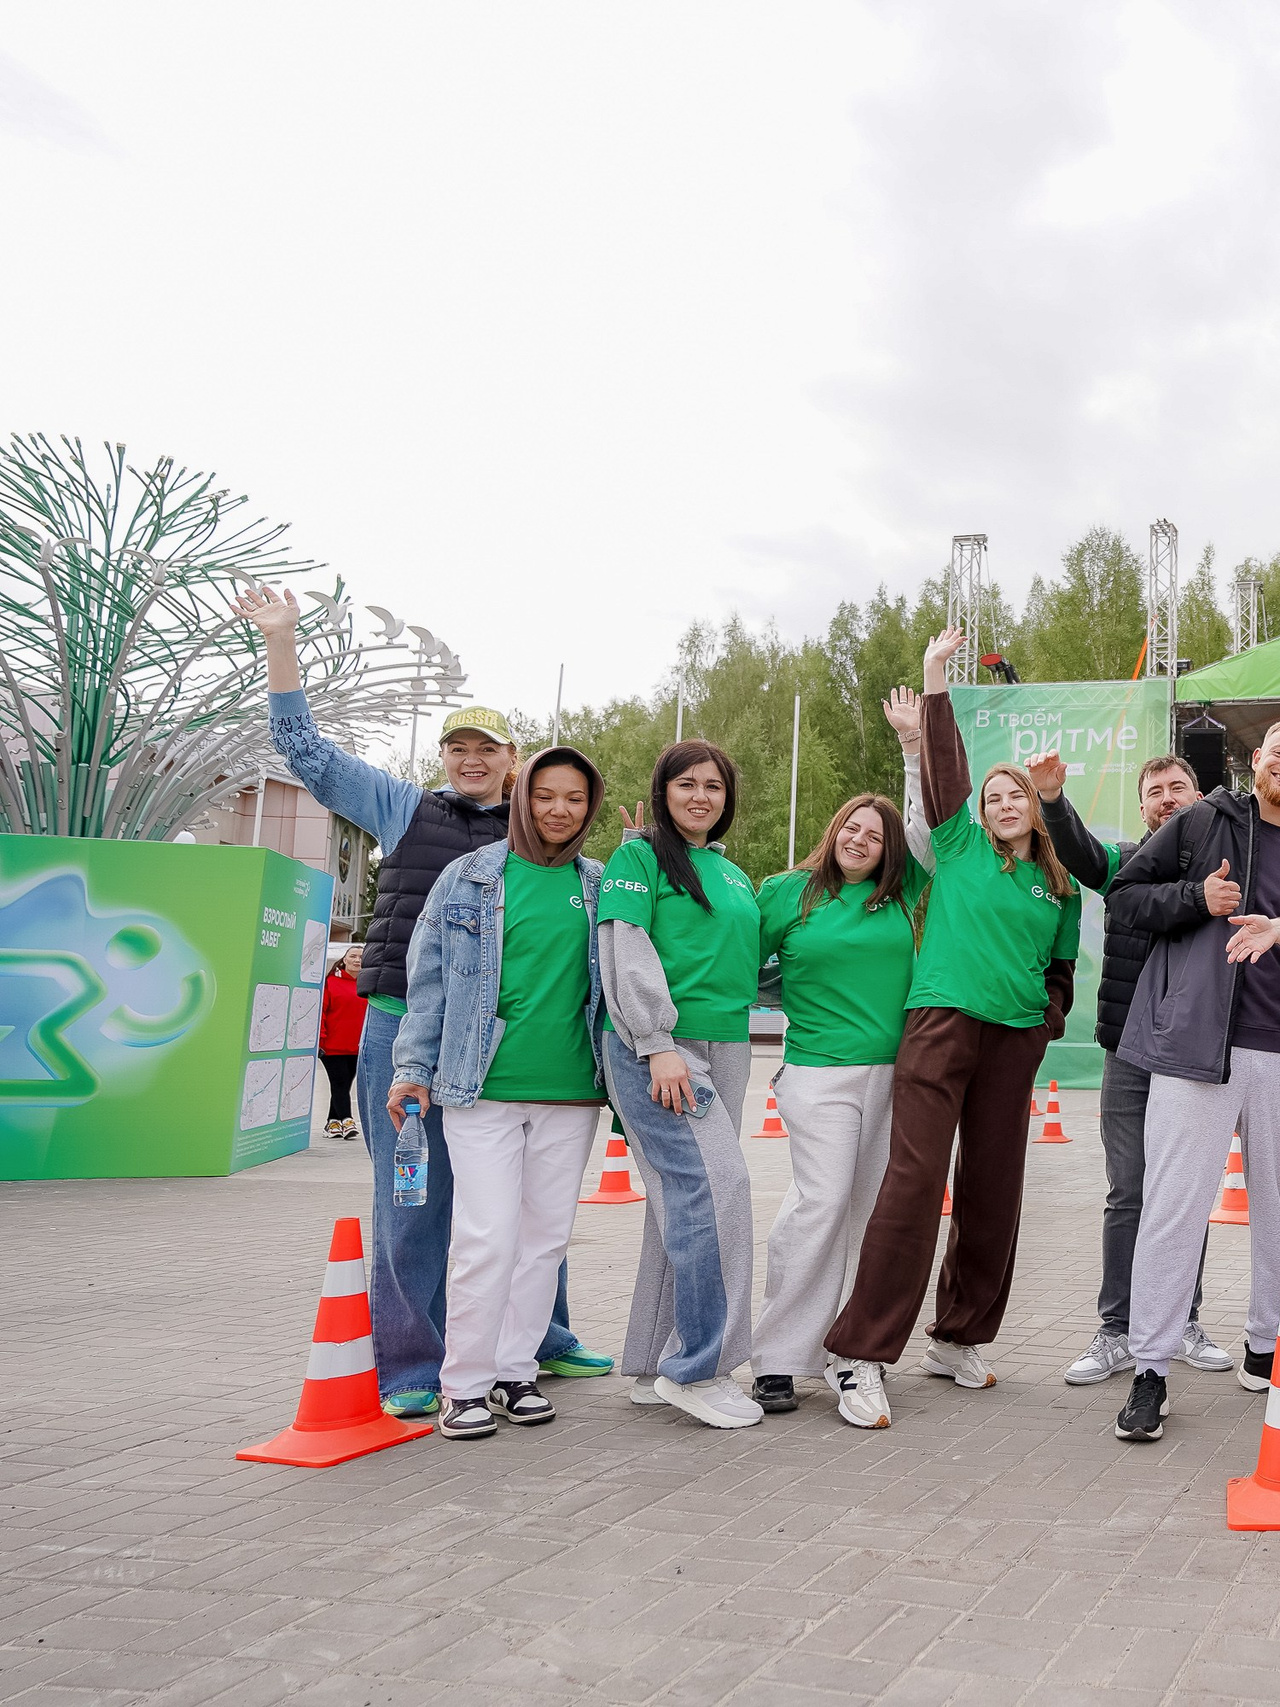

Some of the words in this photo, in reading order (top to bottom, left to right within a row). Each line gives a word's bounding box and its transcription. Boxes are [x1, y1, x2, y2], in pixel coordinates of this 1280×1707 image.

[450, 709, 499, 730] RUSSIA
[976, 709, 991, 728] В
[997, 708, 1063, 728] твоём
[1013, 725, 1138, 763] ритме
[615, 879, 649, 893] СБЕР
[1045, 892, 1063, 910] СБЕ
[263, 906, 297, 930] ВЗРОСЛЫЙ
[260, 929, 281, 948] ЗАБЕГ
